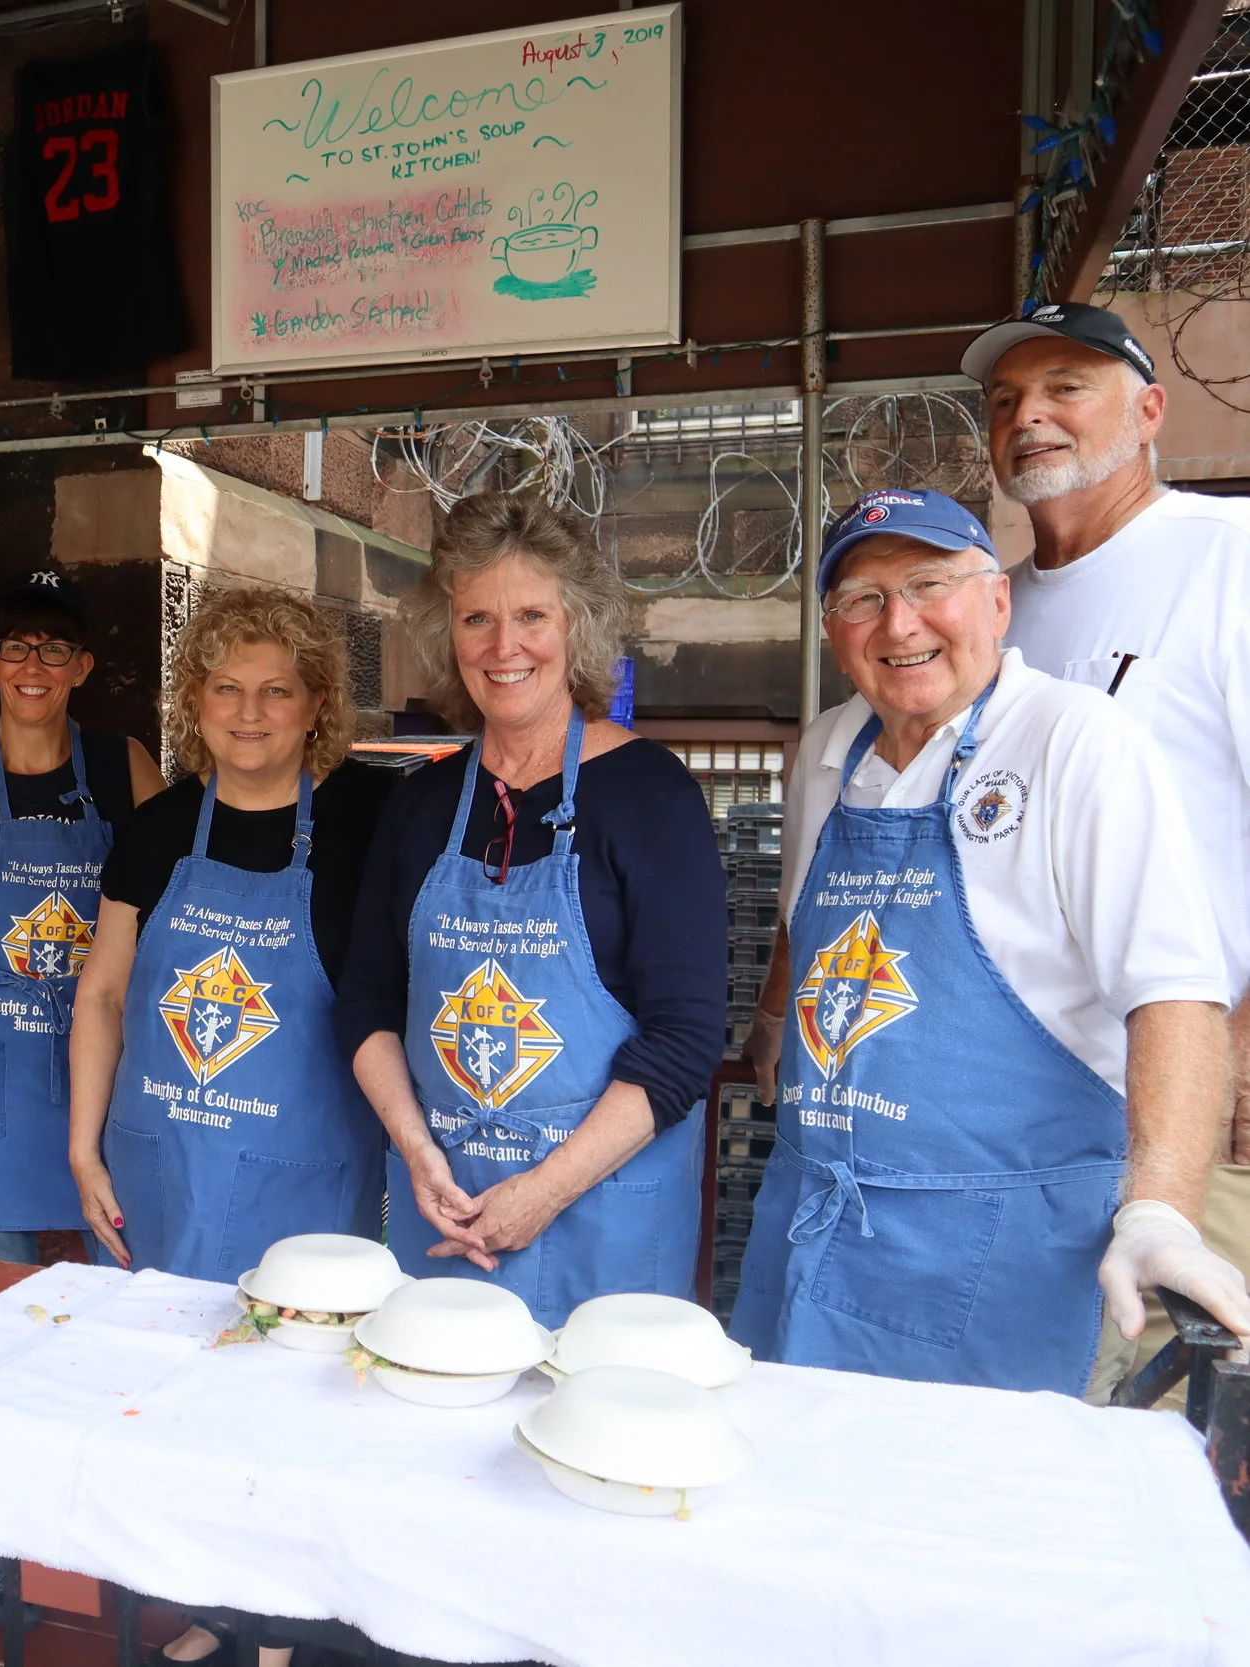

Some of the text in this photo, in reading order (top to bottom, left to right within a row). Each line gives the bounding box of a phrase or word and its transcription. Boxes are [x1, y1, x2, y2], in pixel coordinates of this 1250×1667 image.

[522, 33, 589, 73] August
[624, 24, 664, 43] 2019
[35, 92, 130, 133] JORDAN
[302, 68, 565, 149] Welcome
[321, 150, 353, 168] TO
[480, 121, 526, 141] SOUP
[42, 128, 120, 223] 23
[391, 150, 481, 180] KITCHEN!
[958, 770, 1028, 806] OUR LADY OF VICTORIES
[956, 813, 990, 844] HARRINGTON
[20, 863, 53, 876] Always
[55, 862, 82, 873] Tastes
[837, 871, 873, 890] Always
[902, 868, 935, 888] Right
[1, 871, 25, 884] When
[27, 876, 57, 888] Served
[60, 876, 71, 891] by
[80, 876, 101, 892] Knig
[816, 891, 839, 907] When
[840, 889, 873, 906] Served
[873, 890, 889, 909] by
[31, 924, 76, 939] K OF C
[170, 917, 197, 933] When
[199, 923, 235, 942] Served
[235, 931, 248, 947] by
[249, 938, 255, 946] a
[195, 907, 232, 926] Always
[234, 916, 263, 930] Tastes
[264, 917, 290, 934] Right
[451, 916, 490, 936] Always
[493, 919, 522, 934] Tastes
[525, 918, 558, 938] Right
[429, 932, 455, 949] When
[458, 936, 493, 953] Served
[496, 939, 508, 957] by
[510, 945, 517, 954] a
[827, 955, 839, 977] K
[194, 979, 246, 1003] K OF C
[32, 1005, 44, 1016] o
[461, 1000, 516, 1024] K OF C
[14, 1016, 54, 1033] Insur
[143, 1076, 279, 1118] Knights of Columbus
[811, 1083, 827, 1103] of
[167, 1100, 232, 1129] Insurance
[798, 1109, 854, 1132] nsuranc
